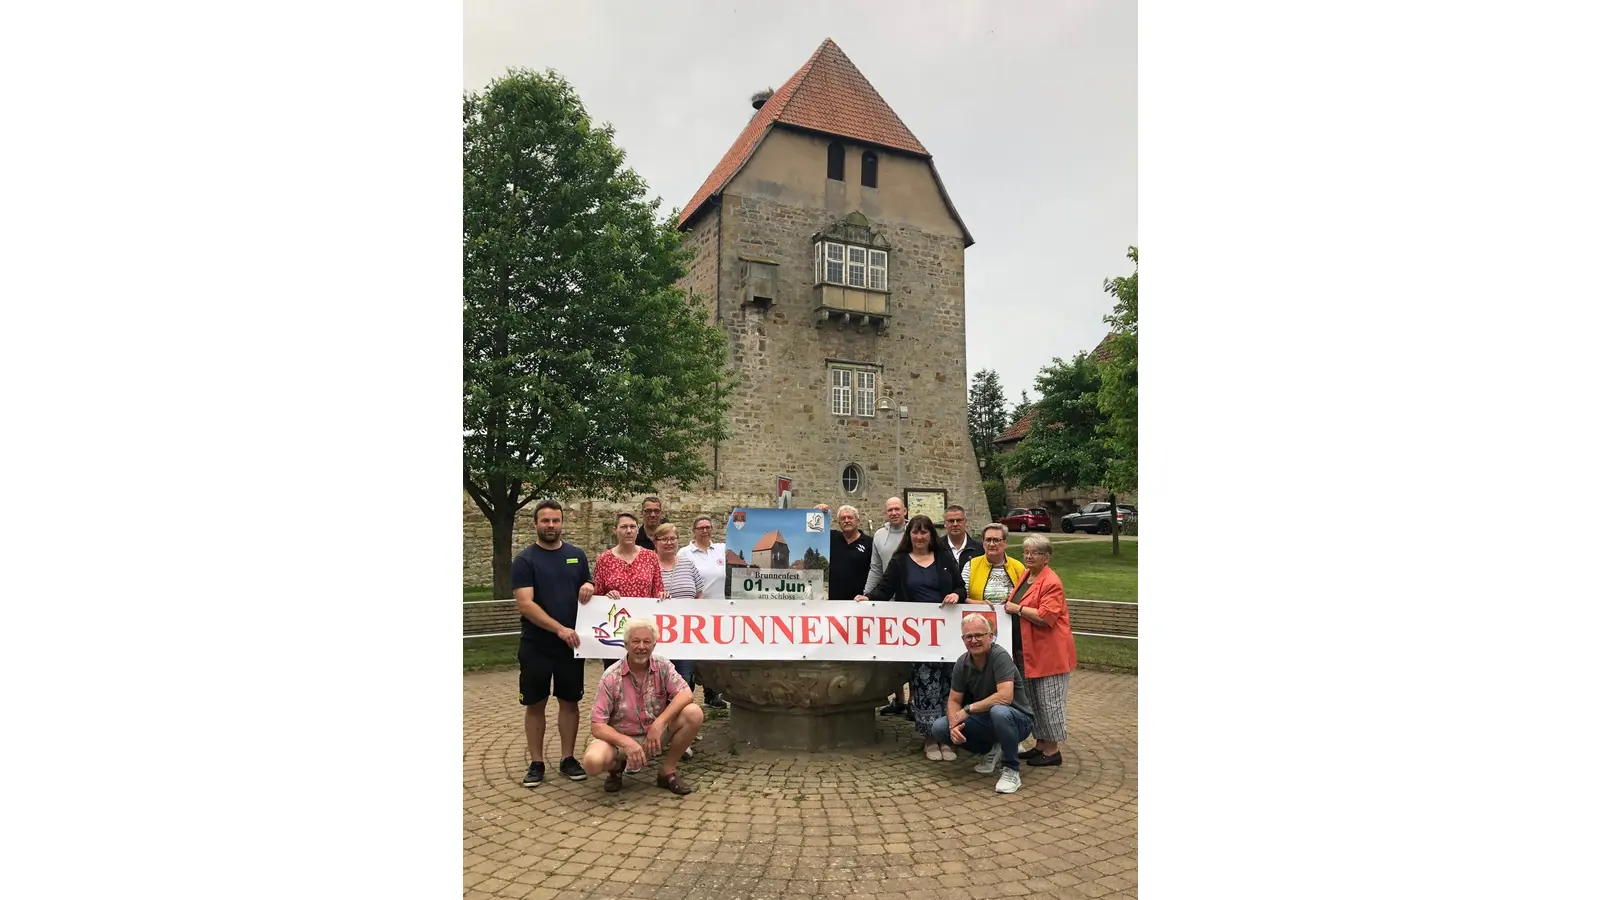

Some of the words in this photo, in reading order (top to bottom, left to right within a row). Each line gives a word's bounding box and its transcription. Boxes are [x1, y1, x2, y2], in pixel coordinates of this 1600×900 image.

[755, 571, 799, 580] Brunnenfest
[743, 579, 769, 592] 01.
[770, 592, 795, 600] Schloss
[653, 613, 946, 647] BRUNNENFEST
